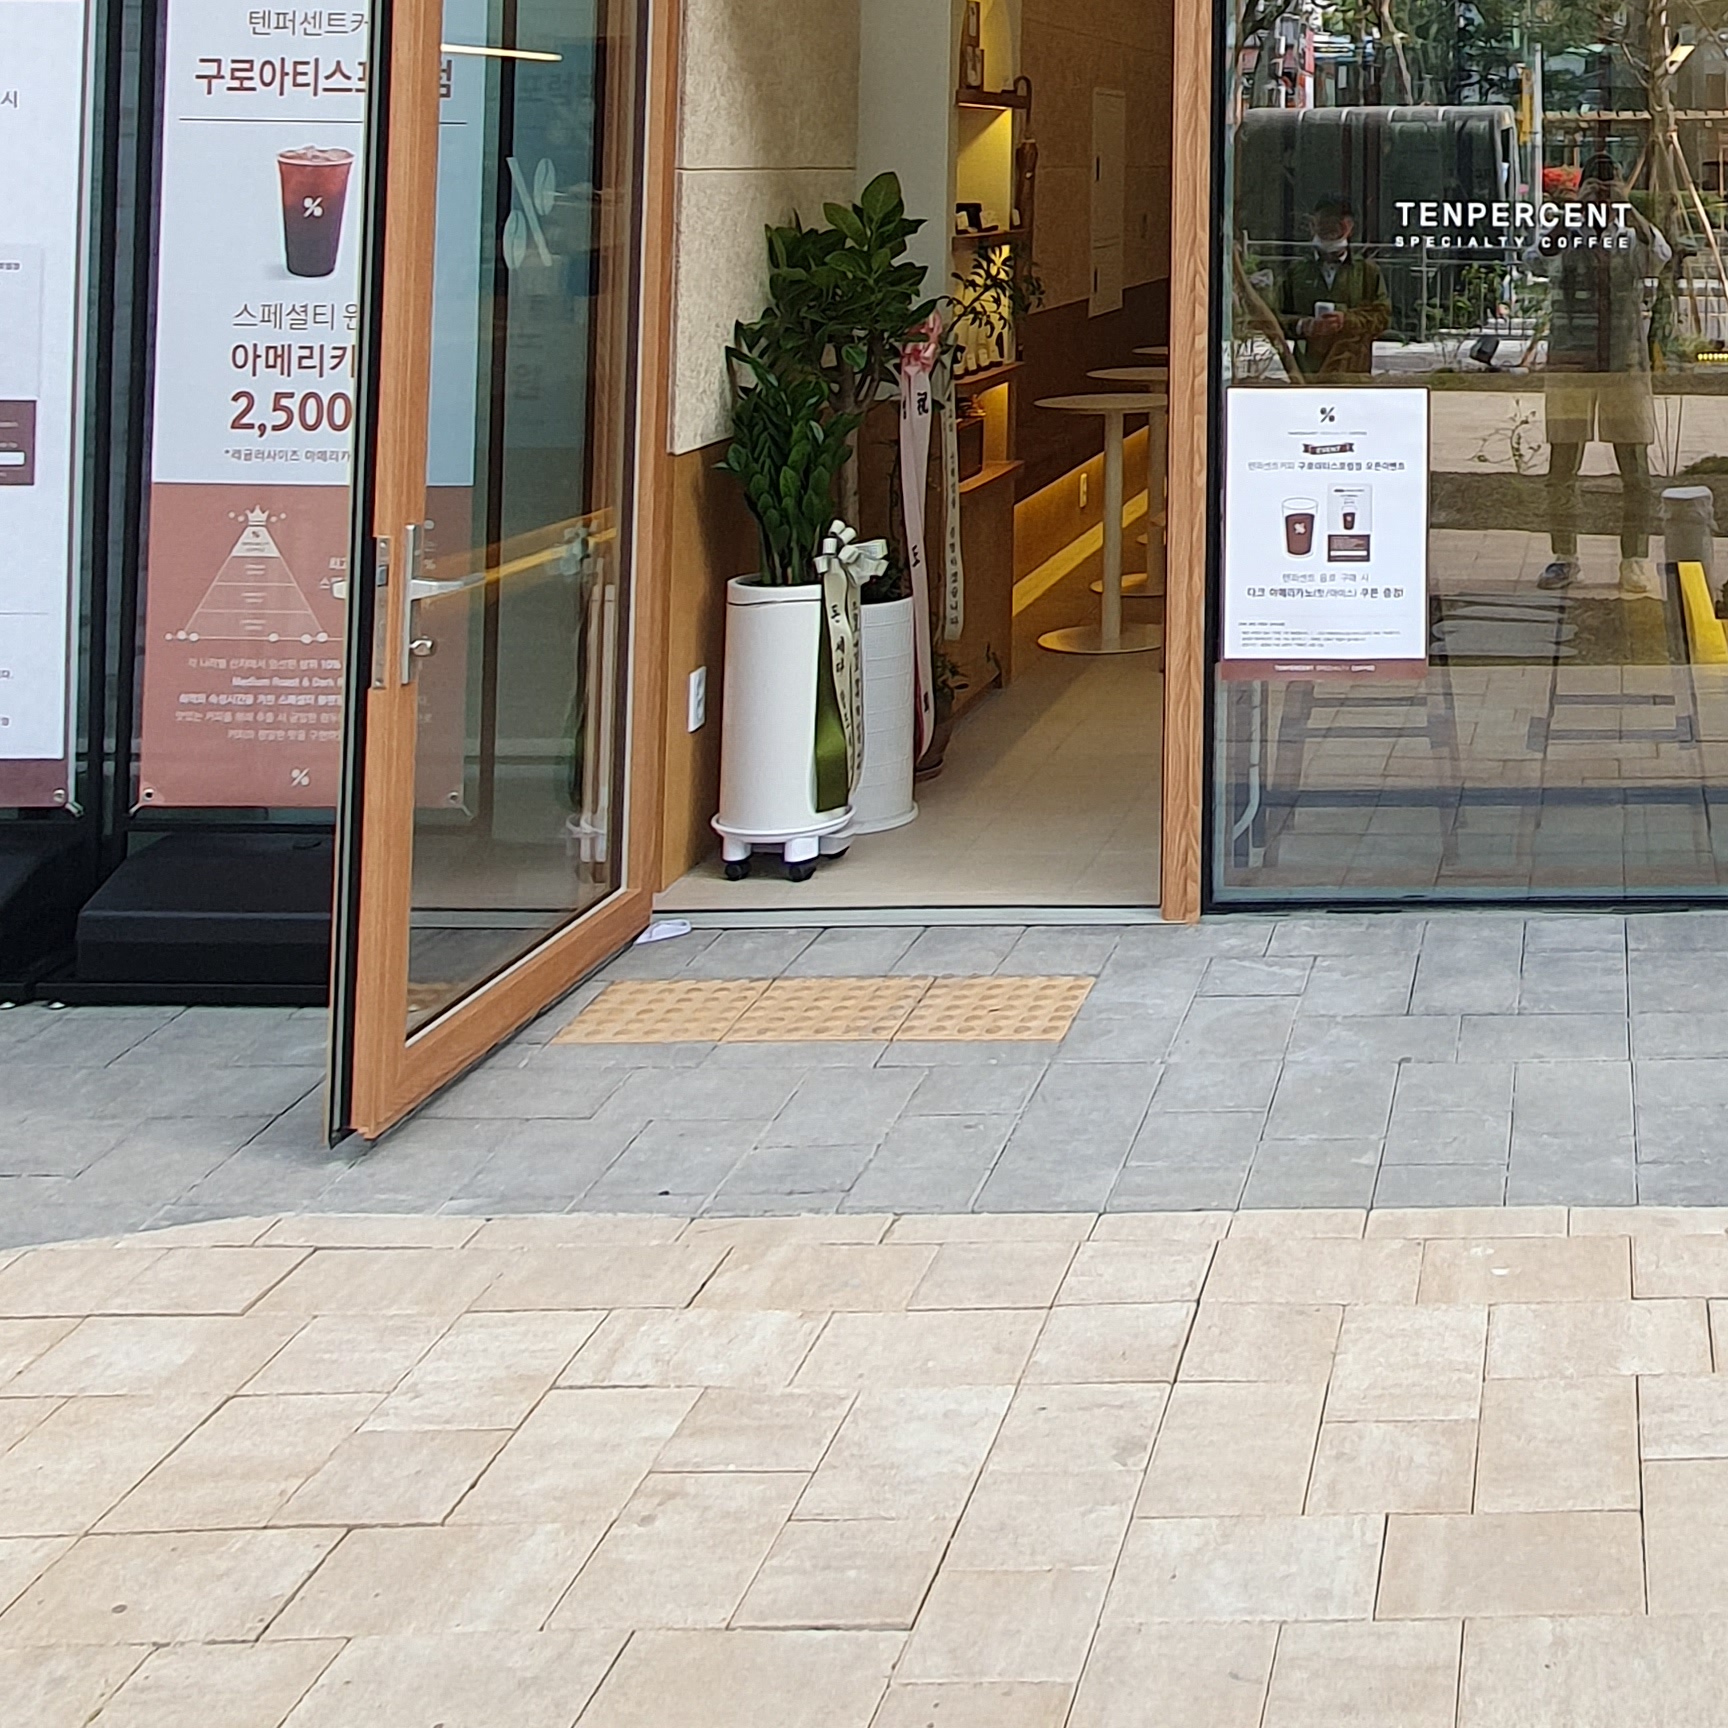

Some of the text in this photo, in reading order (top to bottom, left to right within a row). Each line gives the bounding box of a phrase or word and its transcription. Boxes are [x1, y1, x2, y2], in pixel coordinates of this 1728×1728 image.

[1395, 202, 1632, 228] TENPERCENT
[1395, 236, 1630, 249] SPECIALTY COFFEE
[232, 303, 335, 331] 스페셜티
